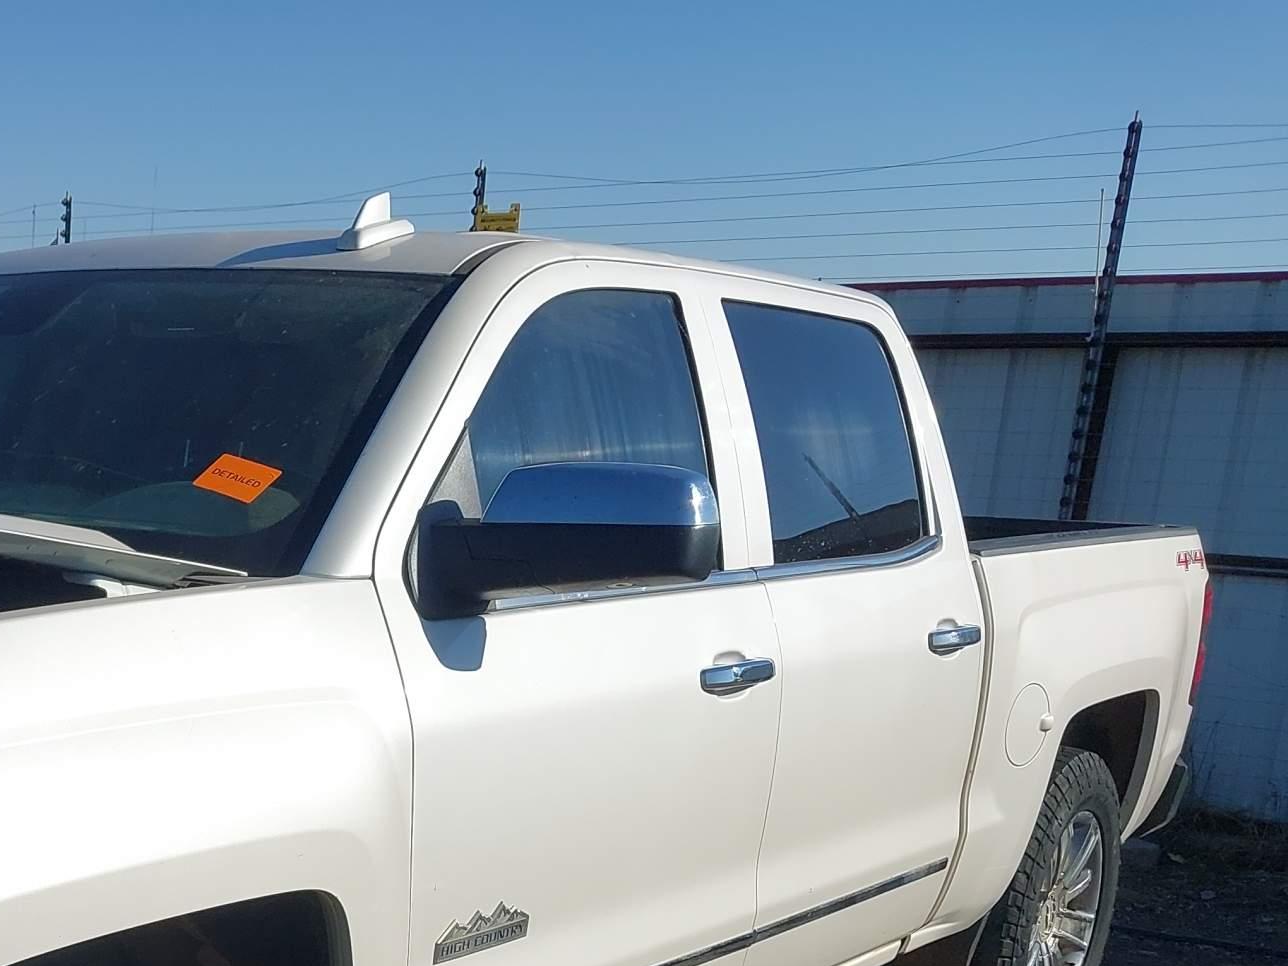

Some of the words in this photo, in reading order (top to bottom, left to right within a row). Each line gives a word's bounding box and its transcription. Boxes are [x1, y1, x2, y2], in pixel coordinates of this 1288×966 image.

[212, 467, 262, 488] DETAILED
[440, 940, 470, 957] HIGH
[474, 924, 524, 947] COUNTRY
